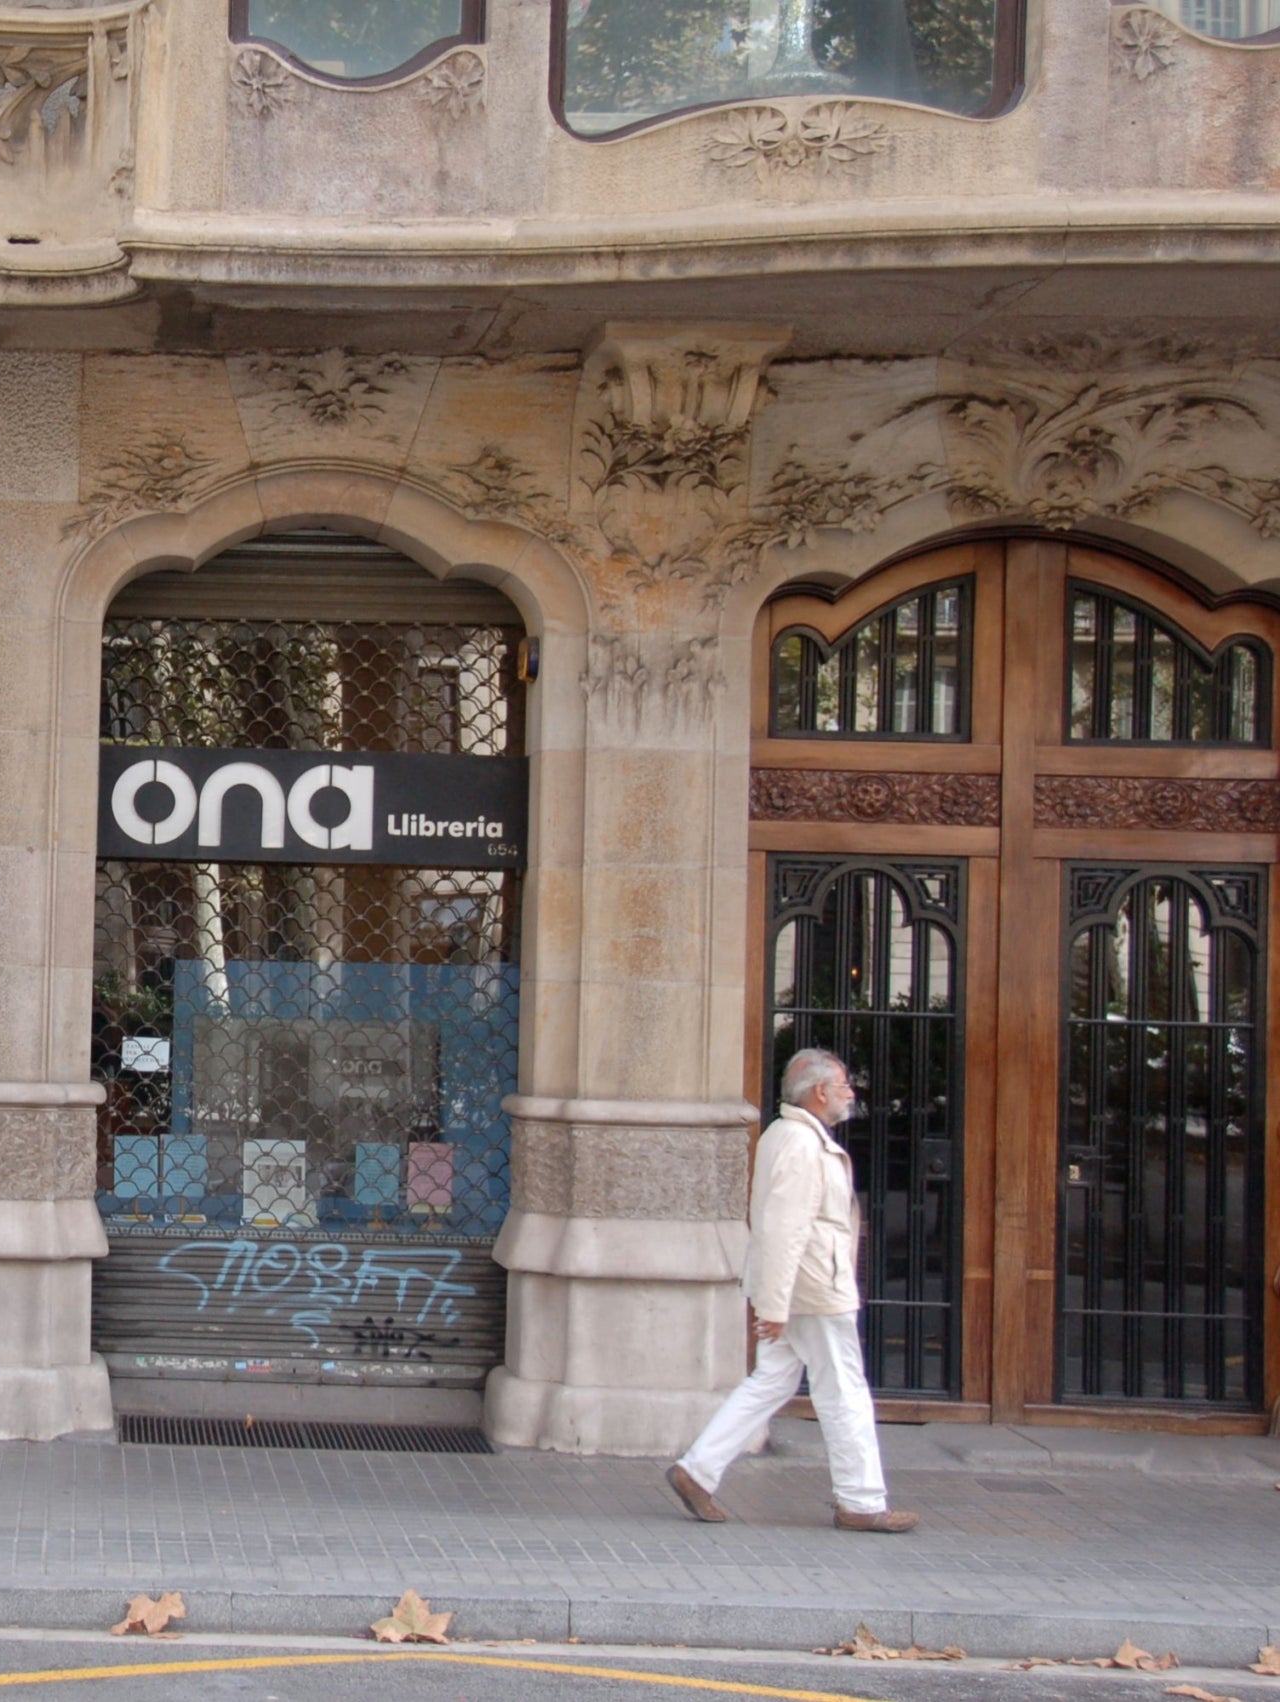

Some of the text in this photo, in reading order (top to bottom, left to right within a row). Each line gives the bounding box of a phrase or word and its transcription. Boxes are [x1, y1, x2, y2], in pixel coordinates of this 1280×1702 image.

[111, 759, 503, 851] ona Llibreria
[487, 843, 518, 856] 654
